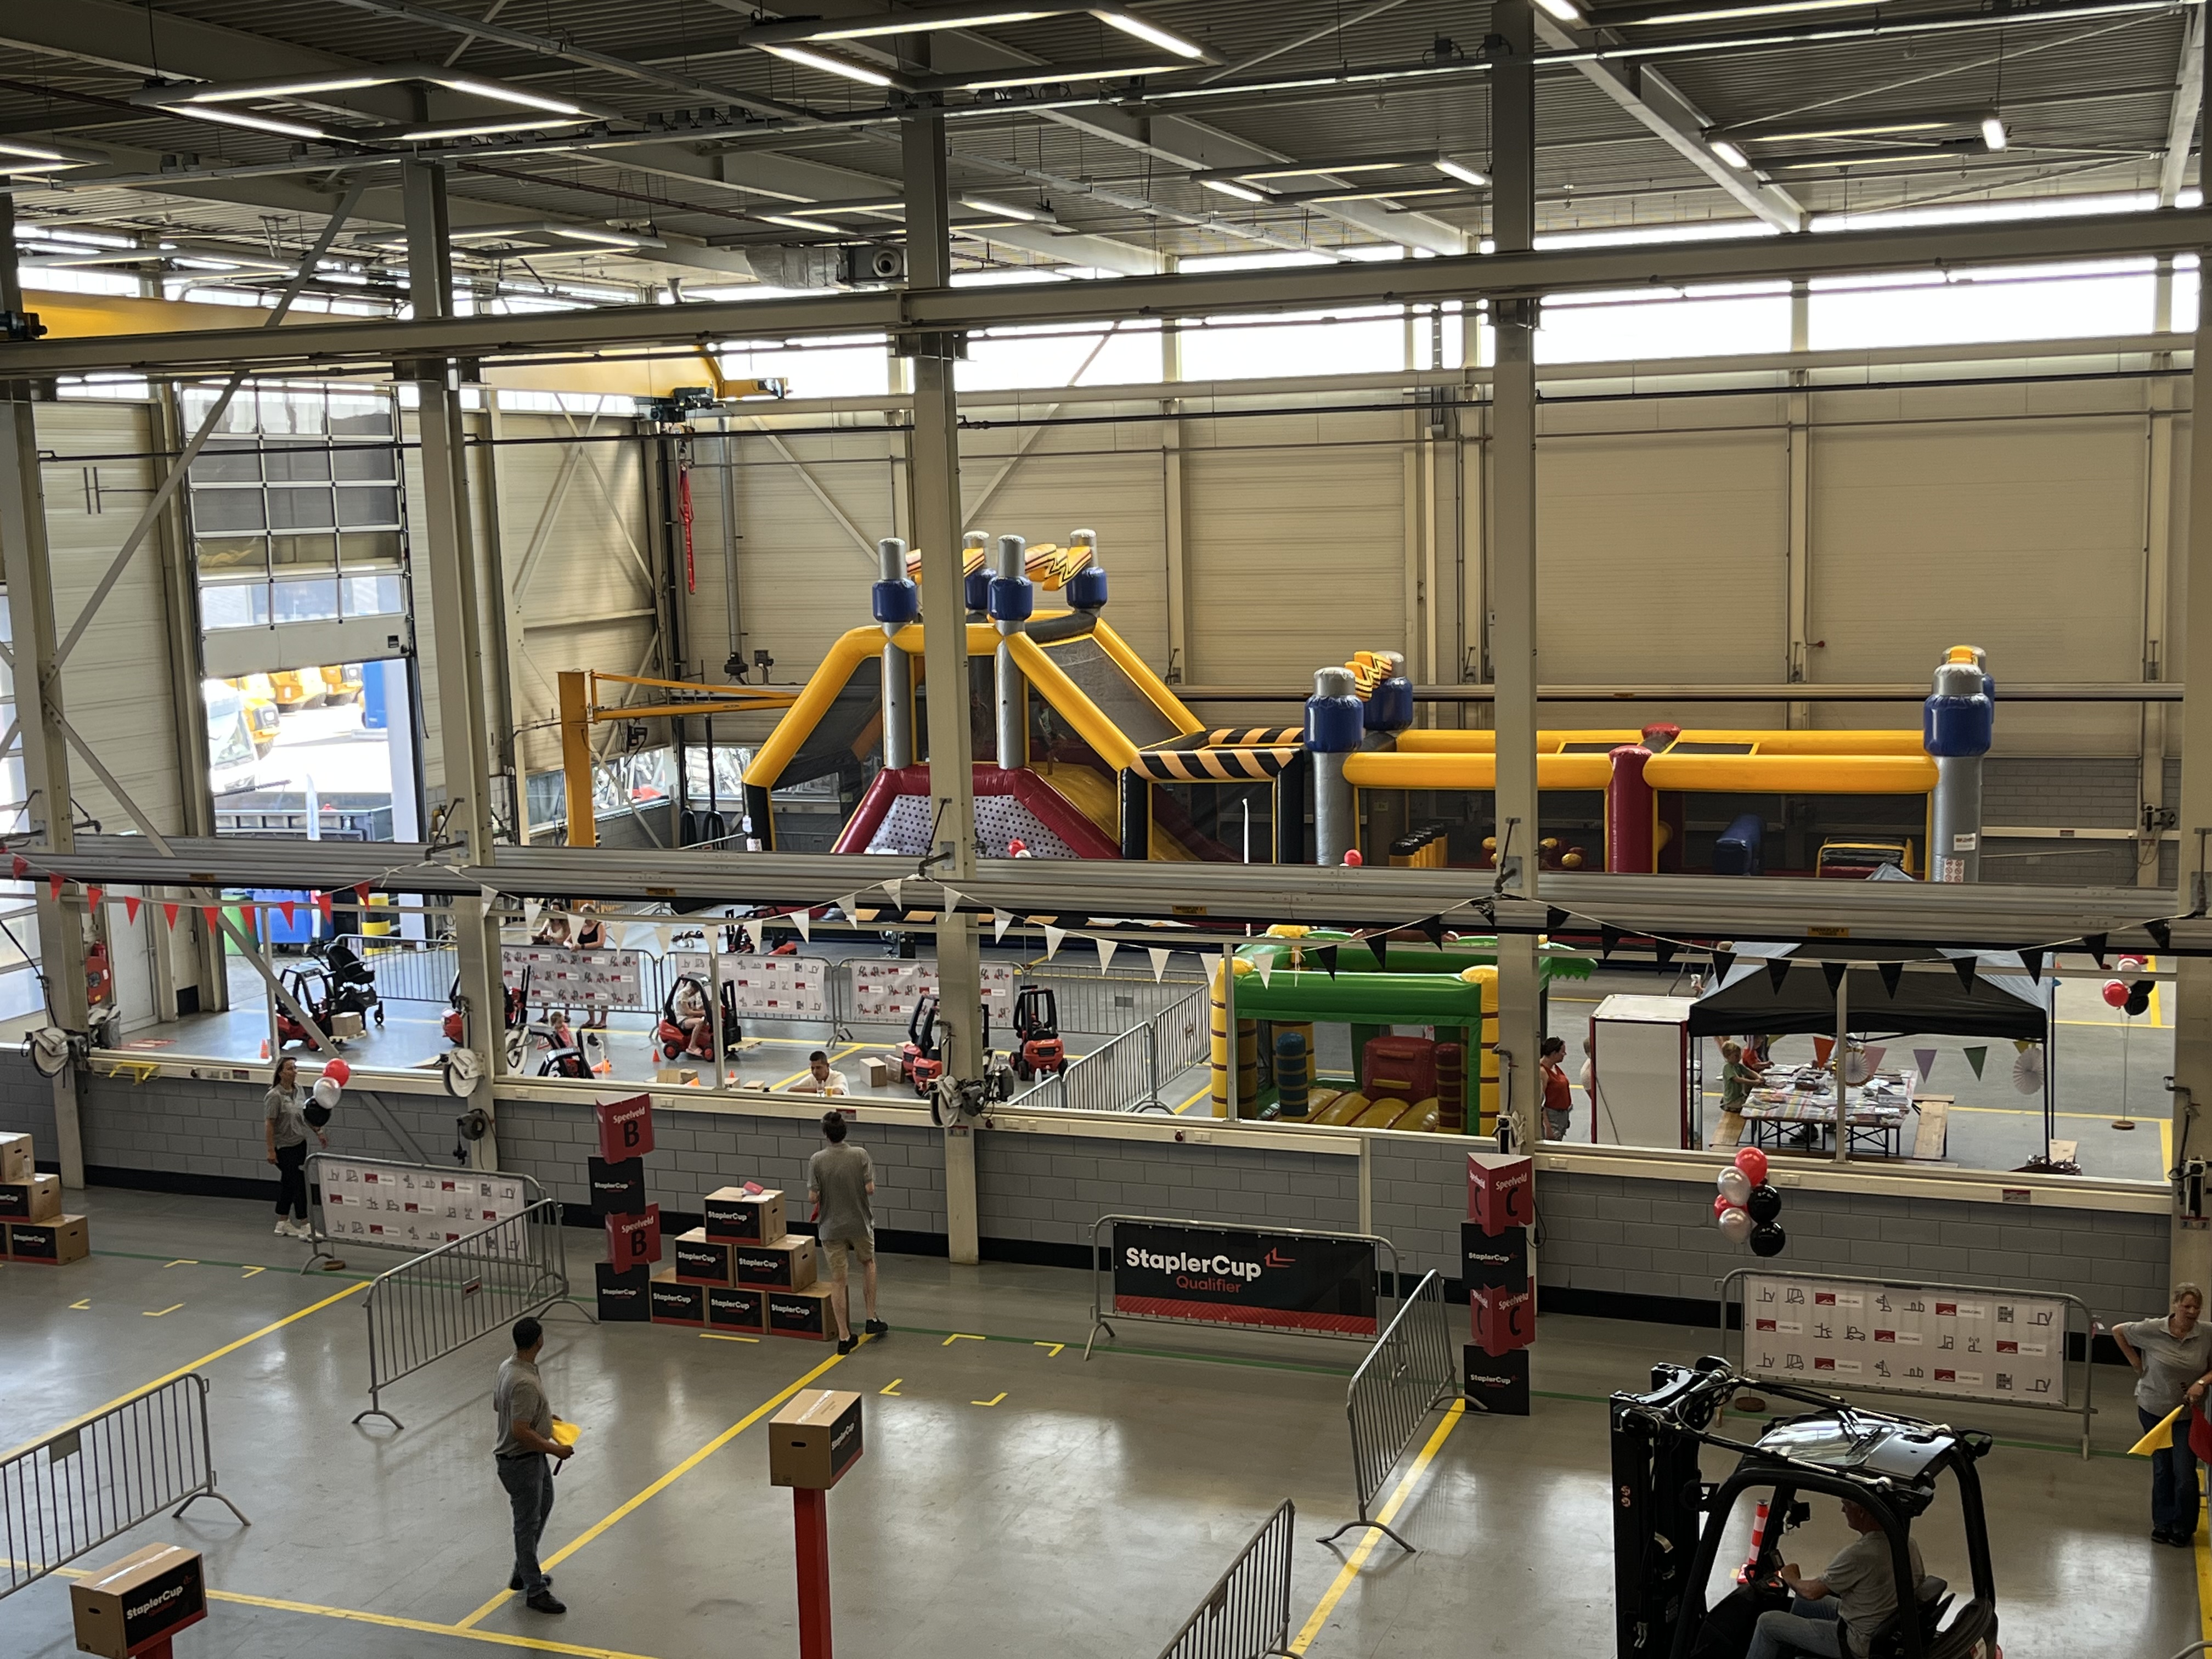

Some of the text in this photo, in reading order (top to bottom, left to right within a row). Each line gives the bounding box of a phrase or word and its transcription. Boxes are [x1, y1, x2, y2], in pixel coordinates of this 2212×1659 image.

[613, 1106, 646, 1124] Speelveld
[624, 1120, 640, 1148] B
[1496, 1172, 1527, 1191] Speelveld
[1506, 1187, 1519, 1217] C
[622, 1215, 654, 1234] Speelveld
[708, 1211, 747, 1222] StaplerCup
[631, 1229, 647, 1257] B
[678, 1251, 715, 1262] StaplerCup
[738, 1257, 778, 1268] StaplerCup
[1126, 1247, 1262, 1282] StaplerCup
[1468, 1252, 1510, 1262] StaplerCup
[1176, 1275, 1242, 1294] Qualifier
[711, 1299, 750, 1310] StaplerCup
[771, 1304, 810, 1316] StaplerCup
[1509, 1306, 1522, 1336] C
[1470, 1374, 1511, 1385] StaplerCup
[126, 1585, 183, 1620] StaplerCup
